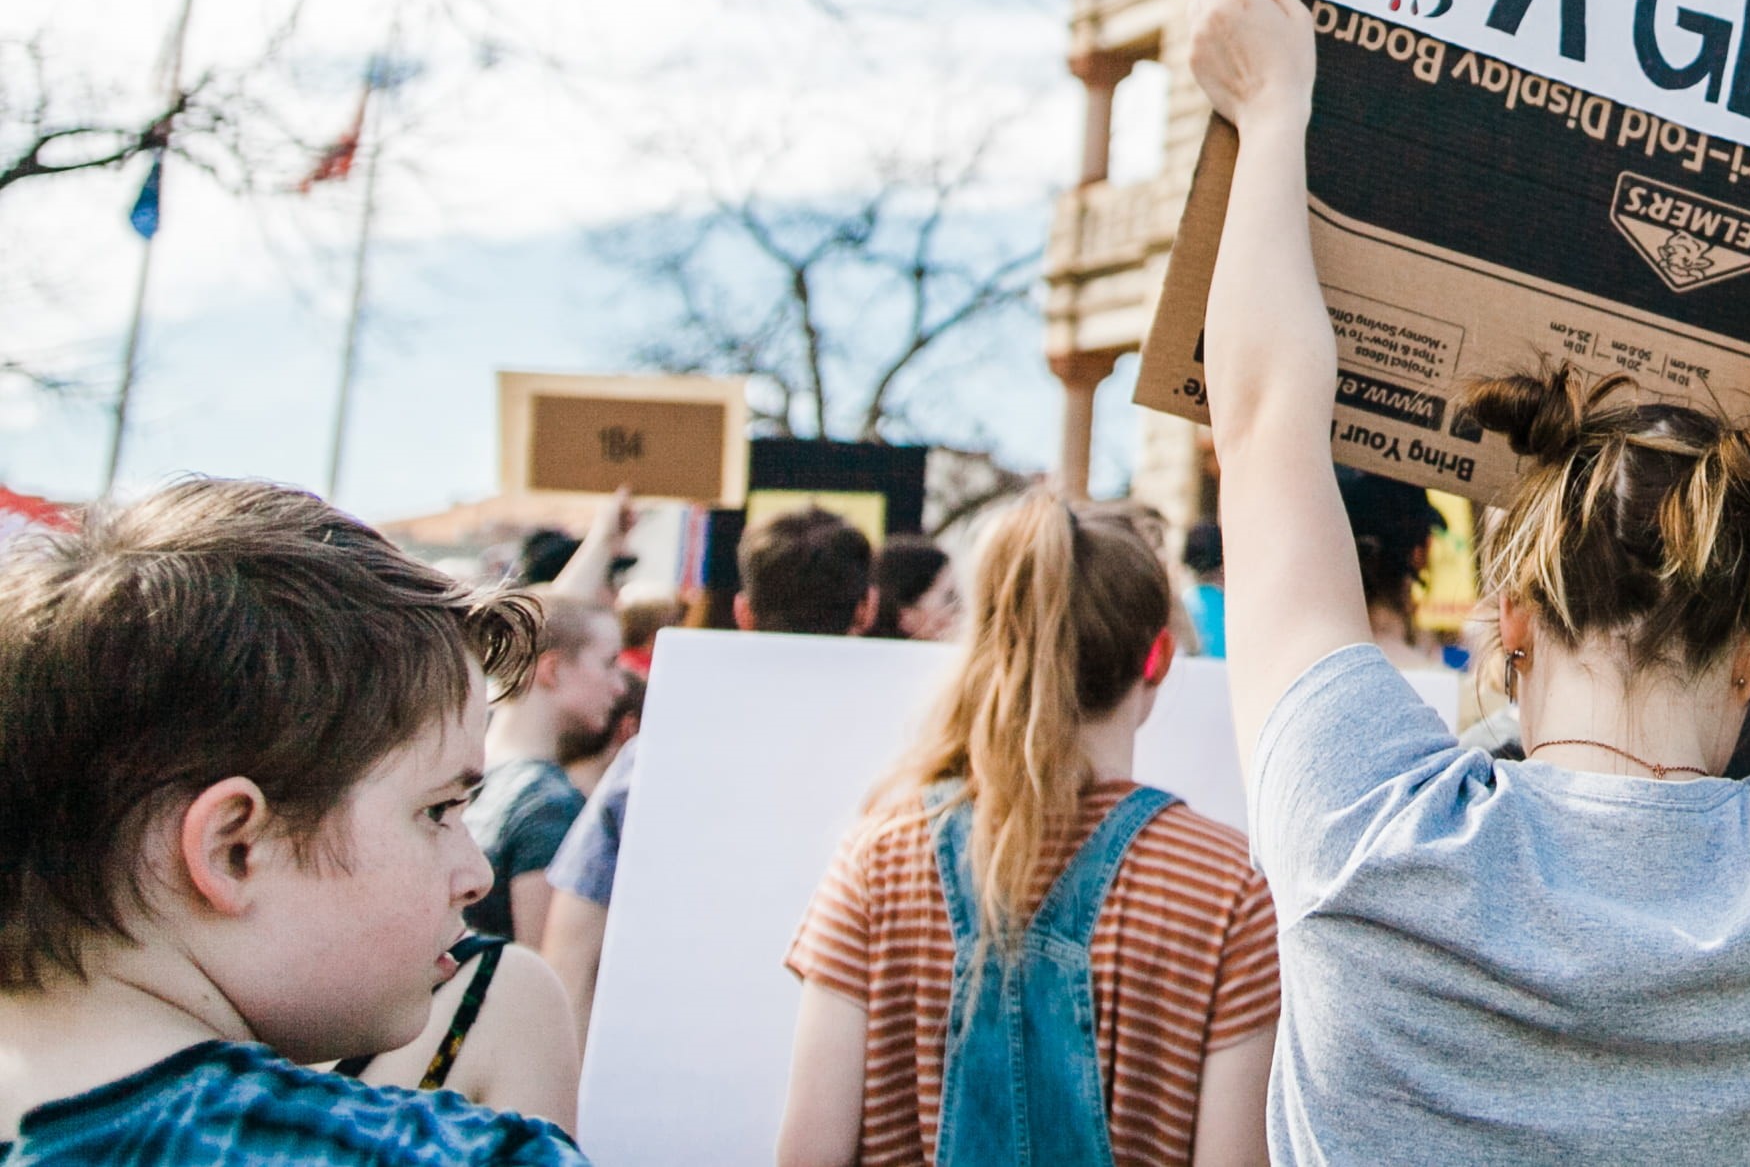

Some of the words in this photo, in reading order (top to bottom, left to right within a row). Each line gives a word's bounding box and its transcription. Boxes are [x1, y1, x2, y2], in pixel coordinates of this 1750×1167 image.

[1451, 52, 1613, 141] Display
[1326, 306, 1354, 324] Offe
[1355, 314, 1397, 336] Saving
[1349, 329, 1398, 353] How-To
[1398, 327, 1440, 349] Money
[1355, 346, 1389, 367] Ideas
[1401, 345, 1411, 356] &
[1413, 350, 1435, 364] Tips
[1390, 355, 1434, 378] Project
[1340, 424, 1401, 461] Your
[1408, 439, 1475, 482] Bring
